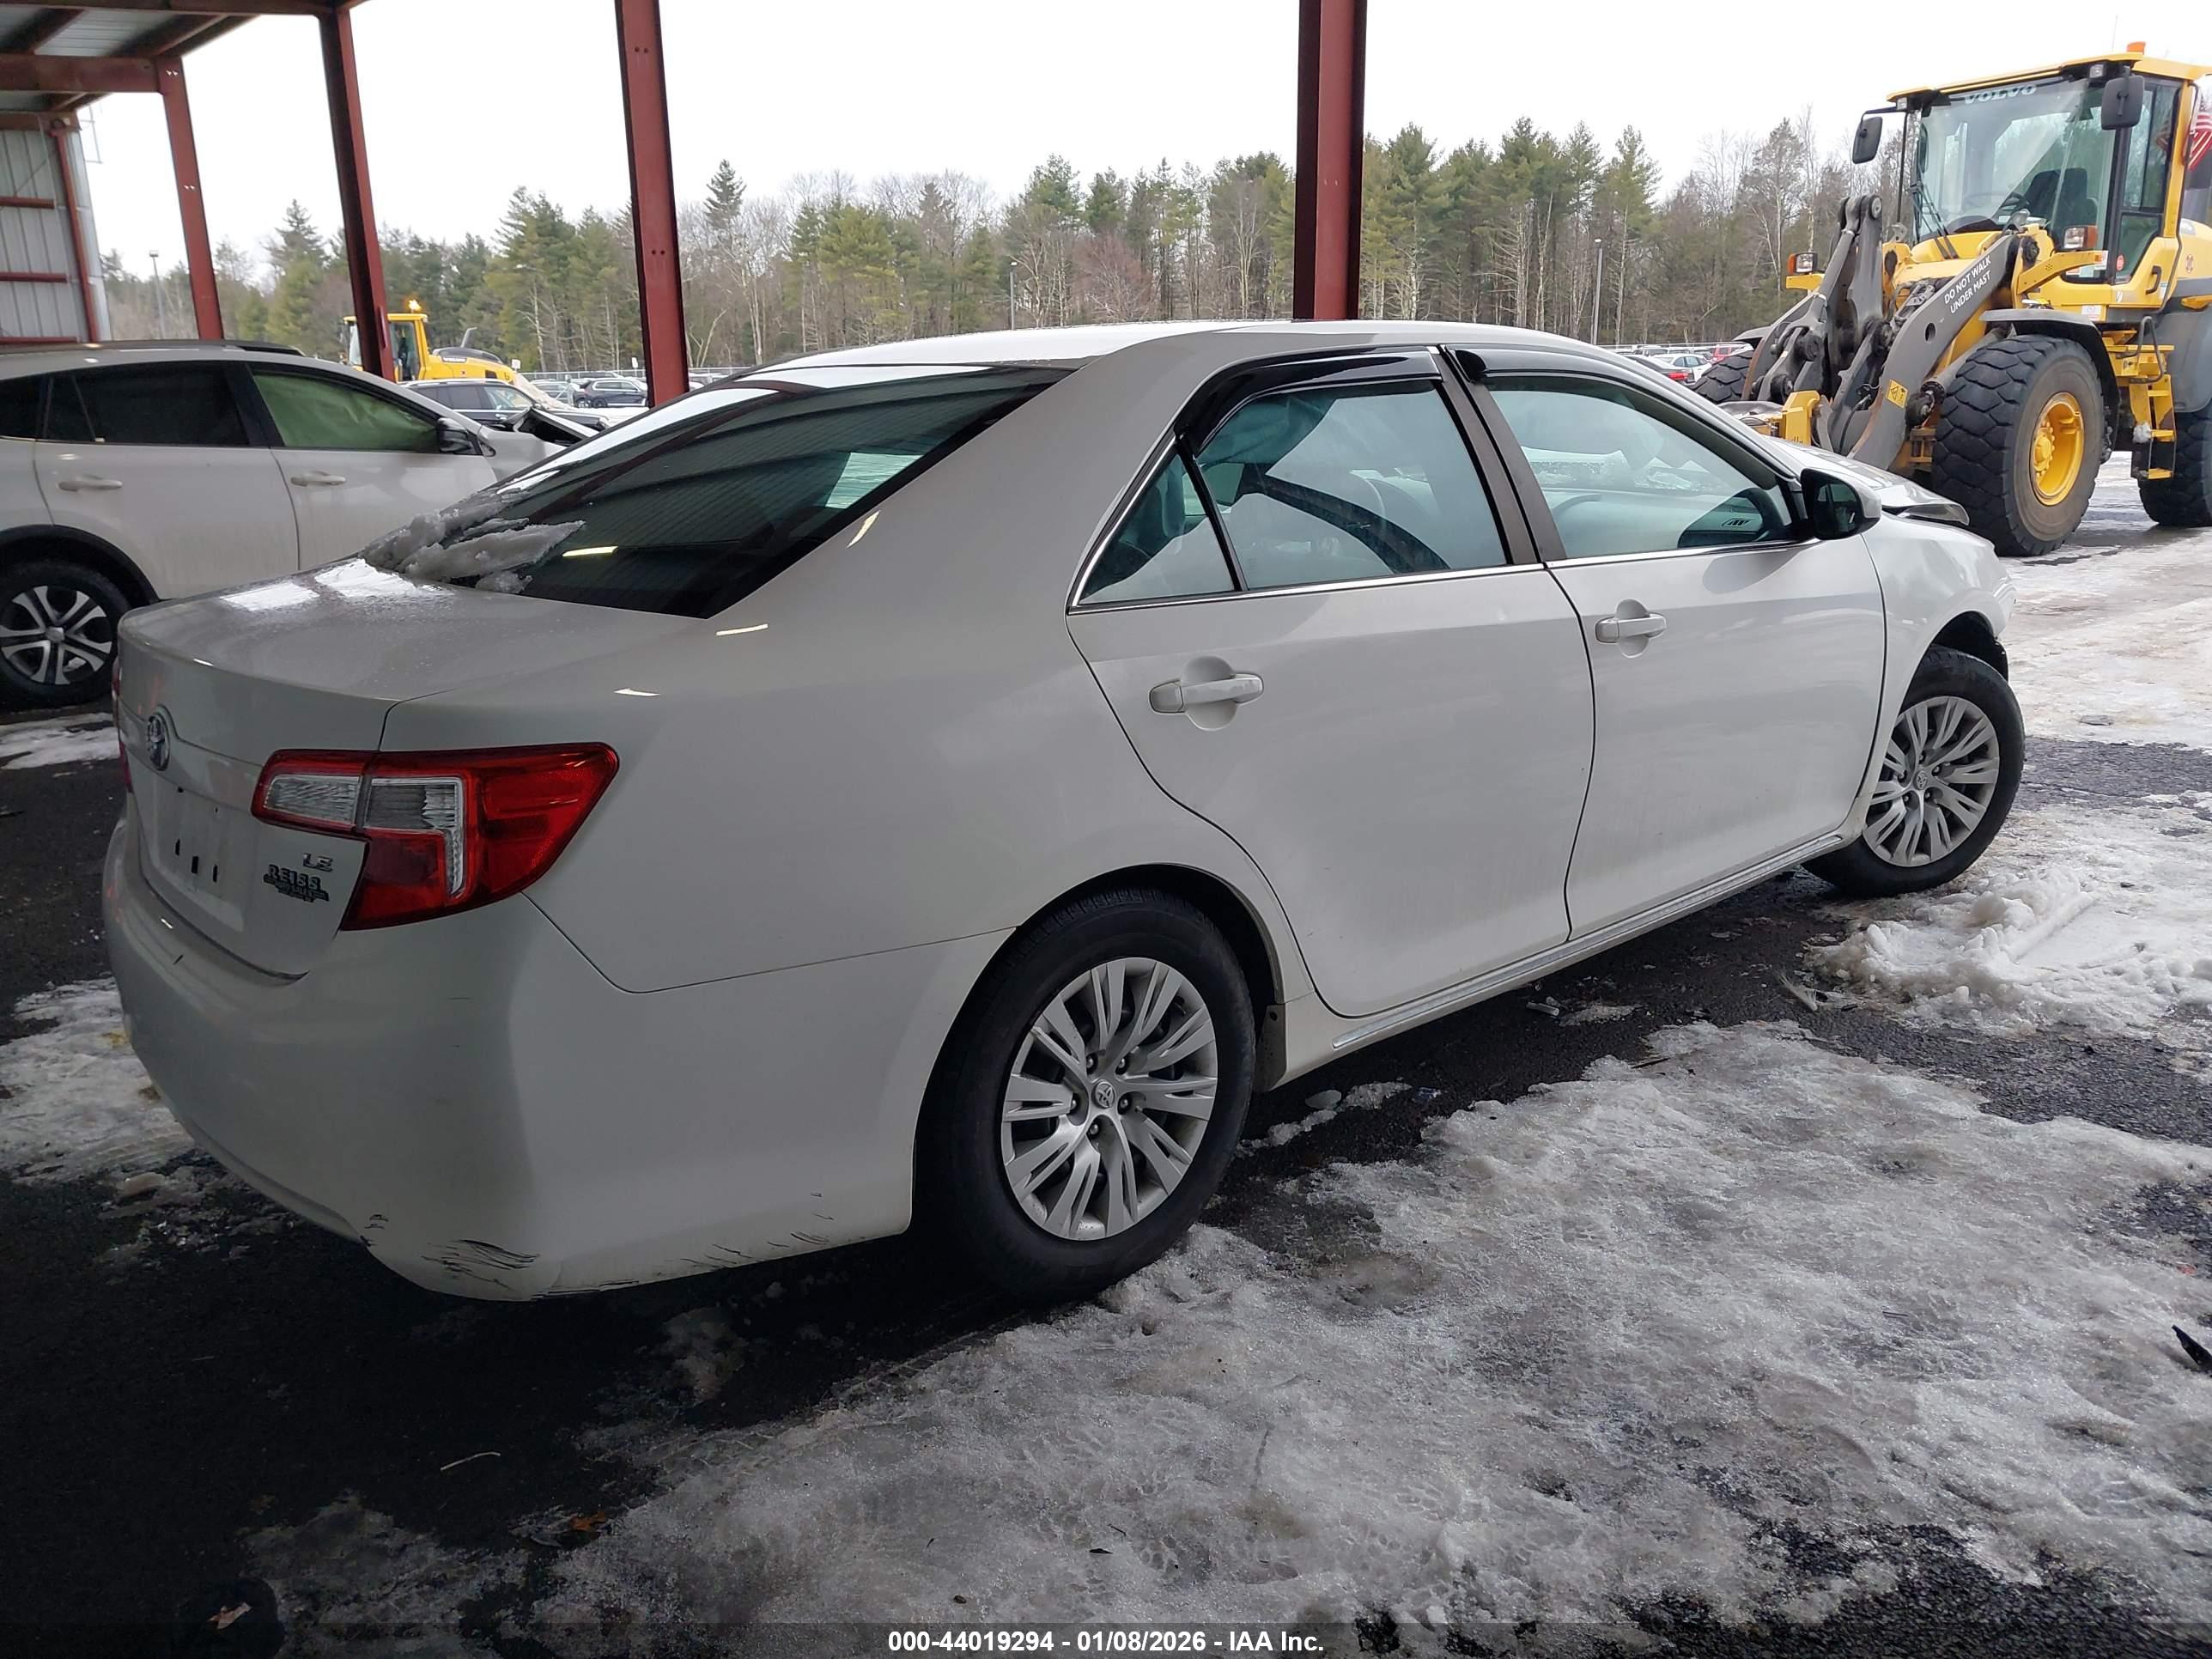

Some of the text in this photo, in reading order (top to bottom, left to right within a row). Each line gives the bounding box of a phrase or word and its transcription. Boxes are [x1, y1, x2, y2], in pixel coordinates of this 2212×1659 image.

[1964, 84, 2038, 104] VOLVO
[1944, 255, 1991, 304] DO NOT WALK
[1950, 270, 1991, 313] UNDER MAST
[302, 853, 333, 872] LE
[268, 864, 321, 890] REISS
